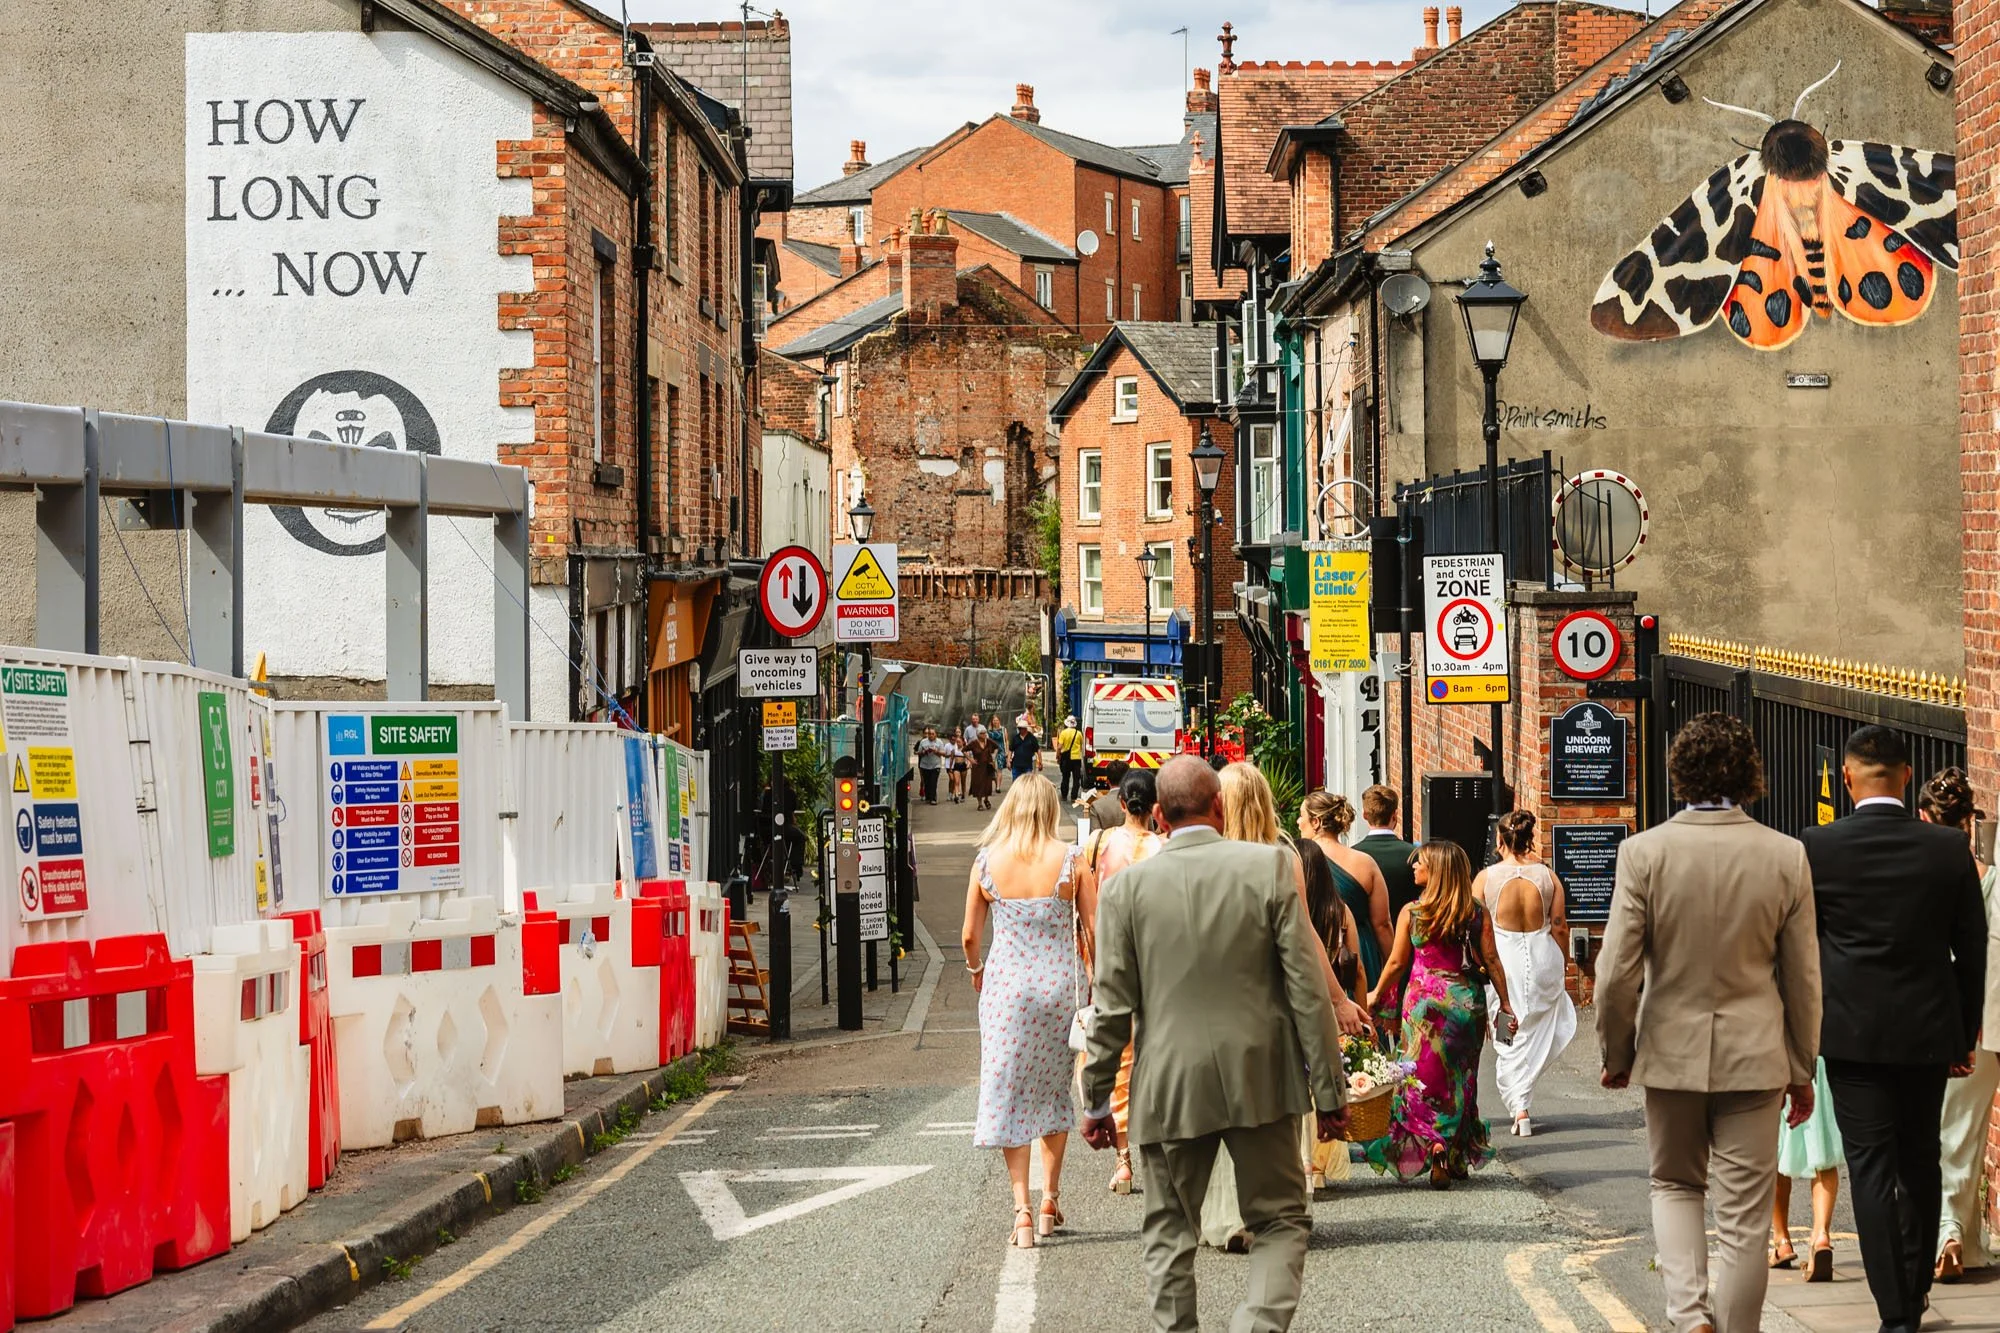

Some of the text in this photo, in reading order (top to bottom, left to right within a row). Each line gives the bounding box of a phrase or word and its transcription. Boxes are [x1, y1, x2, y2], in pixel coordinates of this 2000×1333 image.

[207, 99, 366, 145] HOW
[207, 175, 381, 221] LONG
[272, 251, 428, 297] NOW
[1314, 554, 1332, 567] A1
[1431, 558, 1495, 568] PEDESTRIAN
[1315, 569, 1355, 582] Laser
[1436, 568, 1490, 578] and CYCLE
[854, 588, 885, 597] operation
[1314, 582, 1357, 596] Clinic
[1437, 580, 1491, 598] ZONE
[843, 606, 889, 615] WARNING
[848, 628, 886, 636] TAILGATE
[1567, 630, 1606, 659] 10
[744, 654, 812, 666] Give way to
[1314, 659, 1367, 668] 0161 477 2050
[1431, 662, 1471, 672] 10.30am
[1482, 662, 1504, 672] 4pm
[750, 668, 806, 680] oncoming
[15, 672, 64, 692] SITE SAFETY
[755, 680, 802, 690] vehicles
[1454, 684, 1473, 693] 8am
[1486, 684, 1506, 694] 6pm
[344, 729, 358, 739] RGL
[380, 726, 451, 744] SITE SAFETY
[1566, 736, 1610, 744] UNICORN
[1565, 745, 1612, 754] BREWERY
[216, 779, 228, 798] CCTV
[38, 816, 77, 832] Safety helmets
[41, 832, 77, 844] must be worn
[42, 868, 82, 880] Unauthorised entry
[42, 880, 84, 893] to this site is strictly
[860, 890, 882, 900] ehicle
[860, 900, 882, 910] oceed
